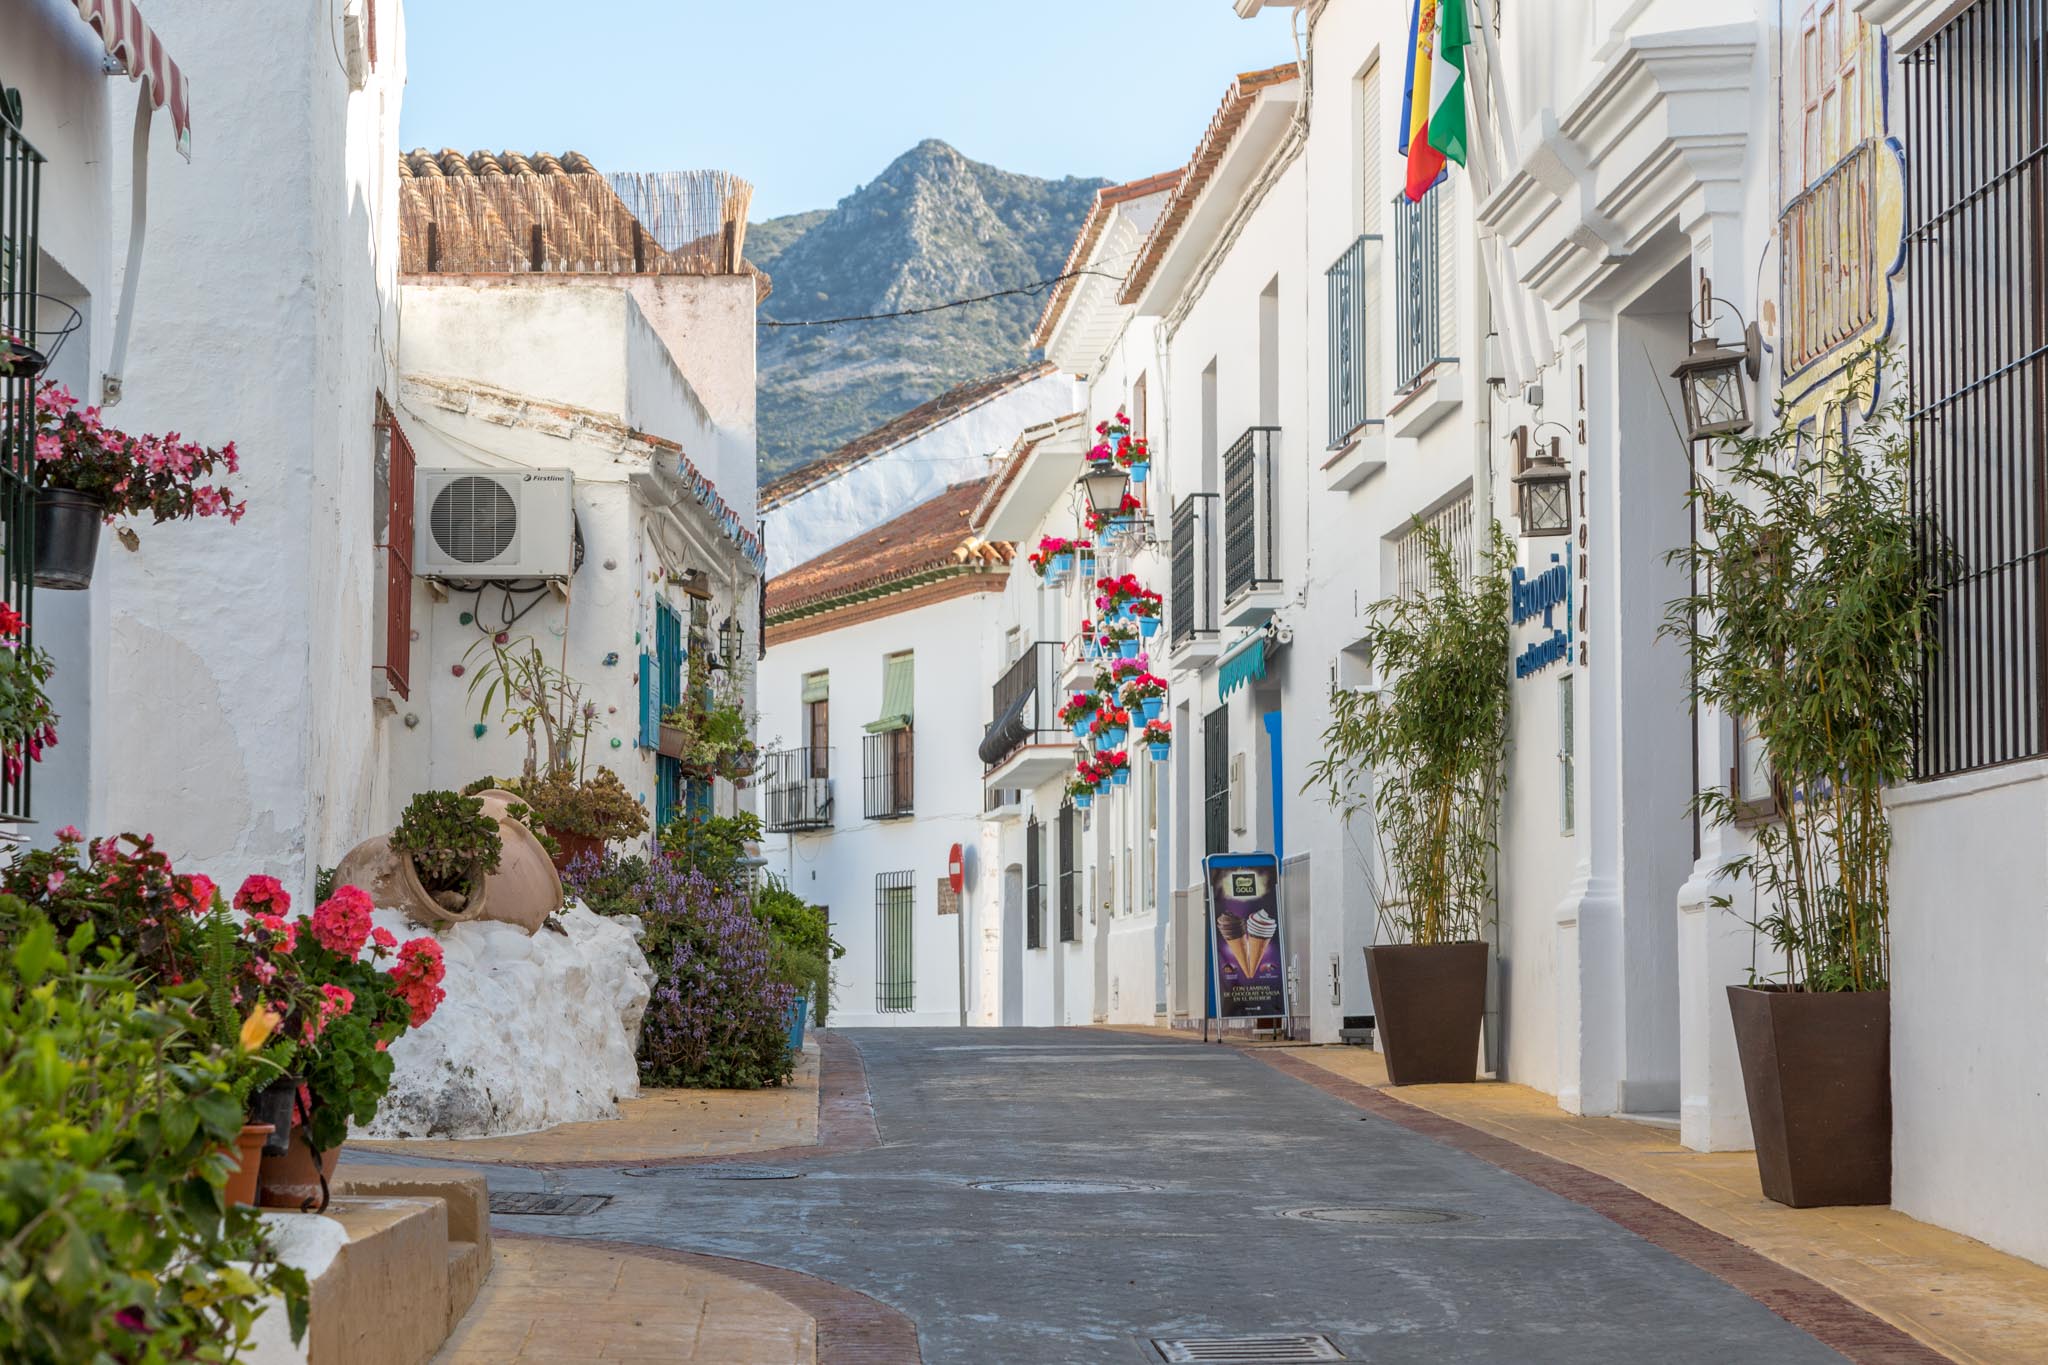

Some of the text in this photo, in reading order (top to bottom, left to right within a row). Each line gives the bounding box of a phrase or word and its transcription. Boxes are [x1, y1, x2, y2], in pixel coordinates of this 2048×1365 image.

[1577, 363, 1589, 667] la fonda
[1516, 629, 1567, 679] restaurante
